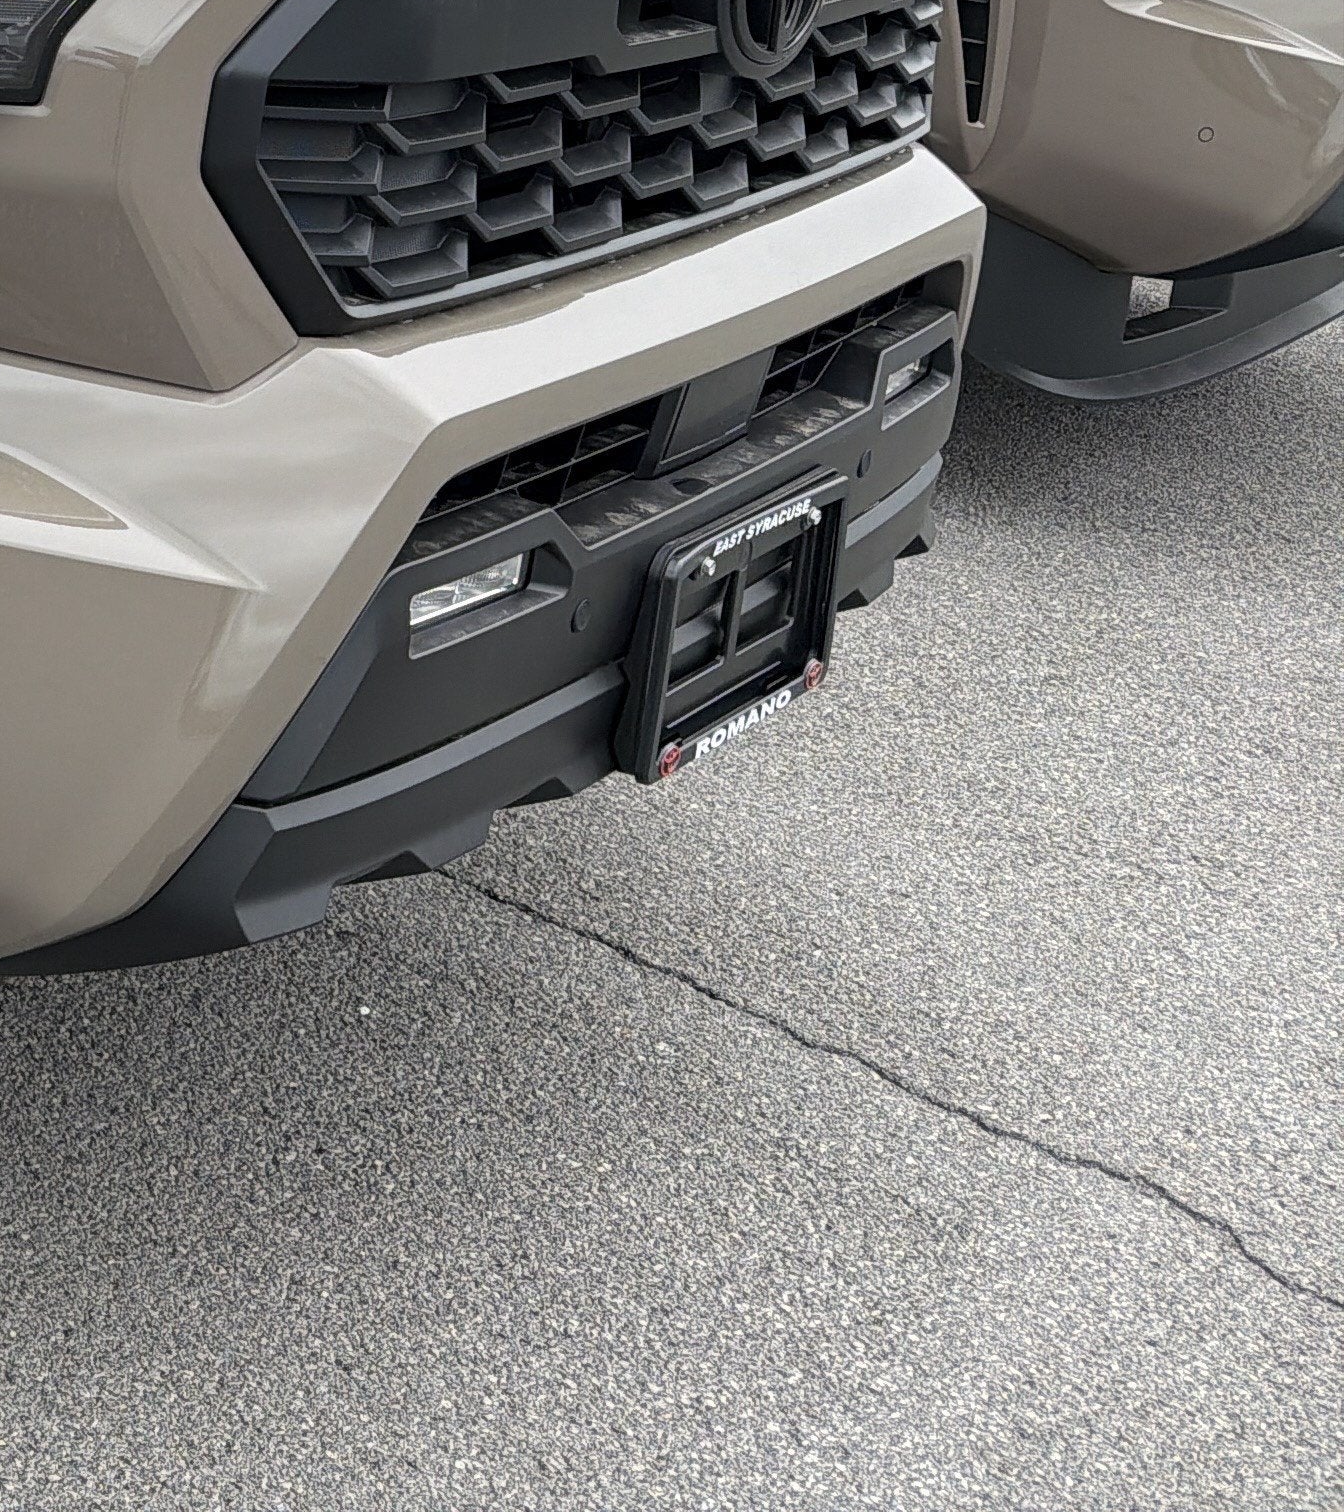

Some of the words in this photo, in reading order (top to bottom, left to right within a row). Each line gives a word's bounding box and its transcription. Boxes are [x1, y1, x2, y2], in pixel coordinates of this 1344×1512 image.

[713, 528, 747, 558] EAST
[746, 497, 813, 540] SYRACUSE
[695, 689, 792, 760] ROMANO
